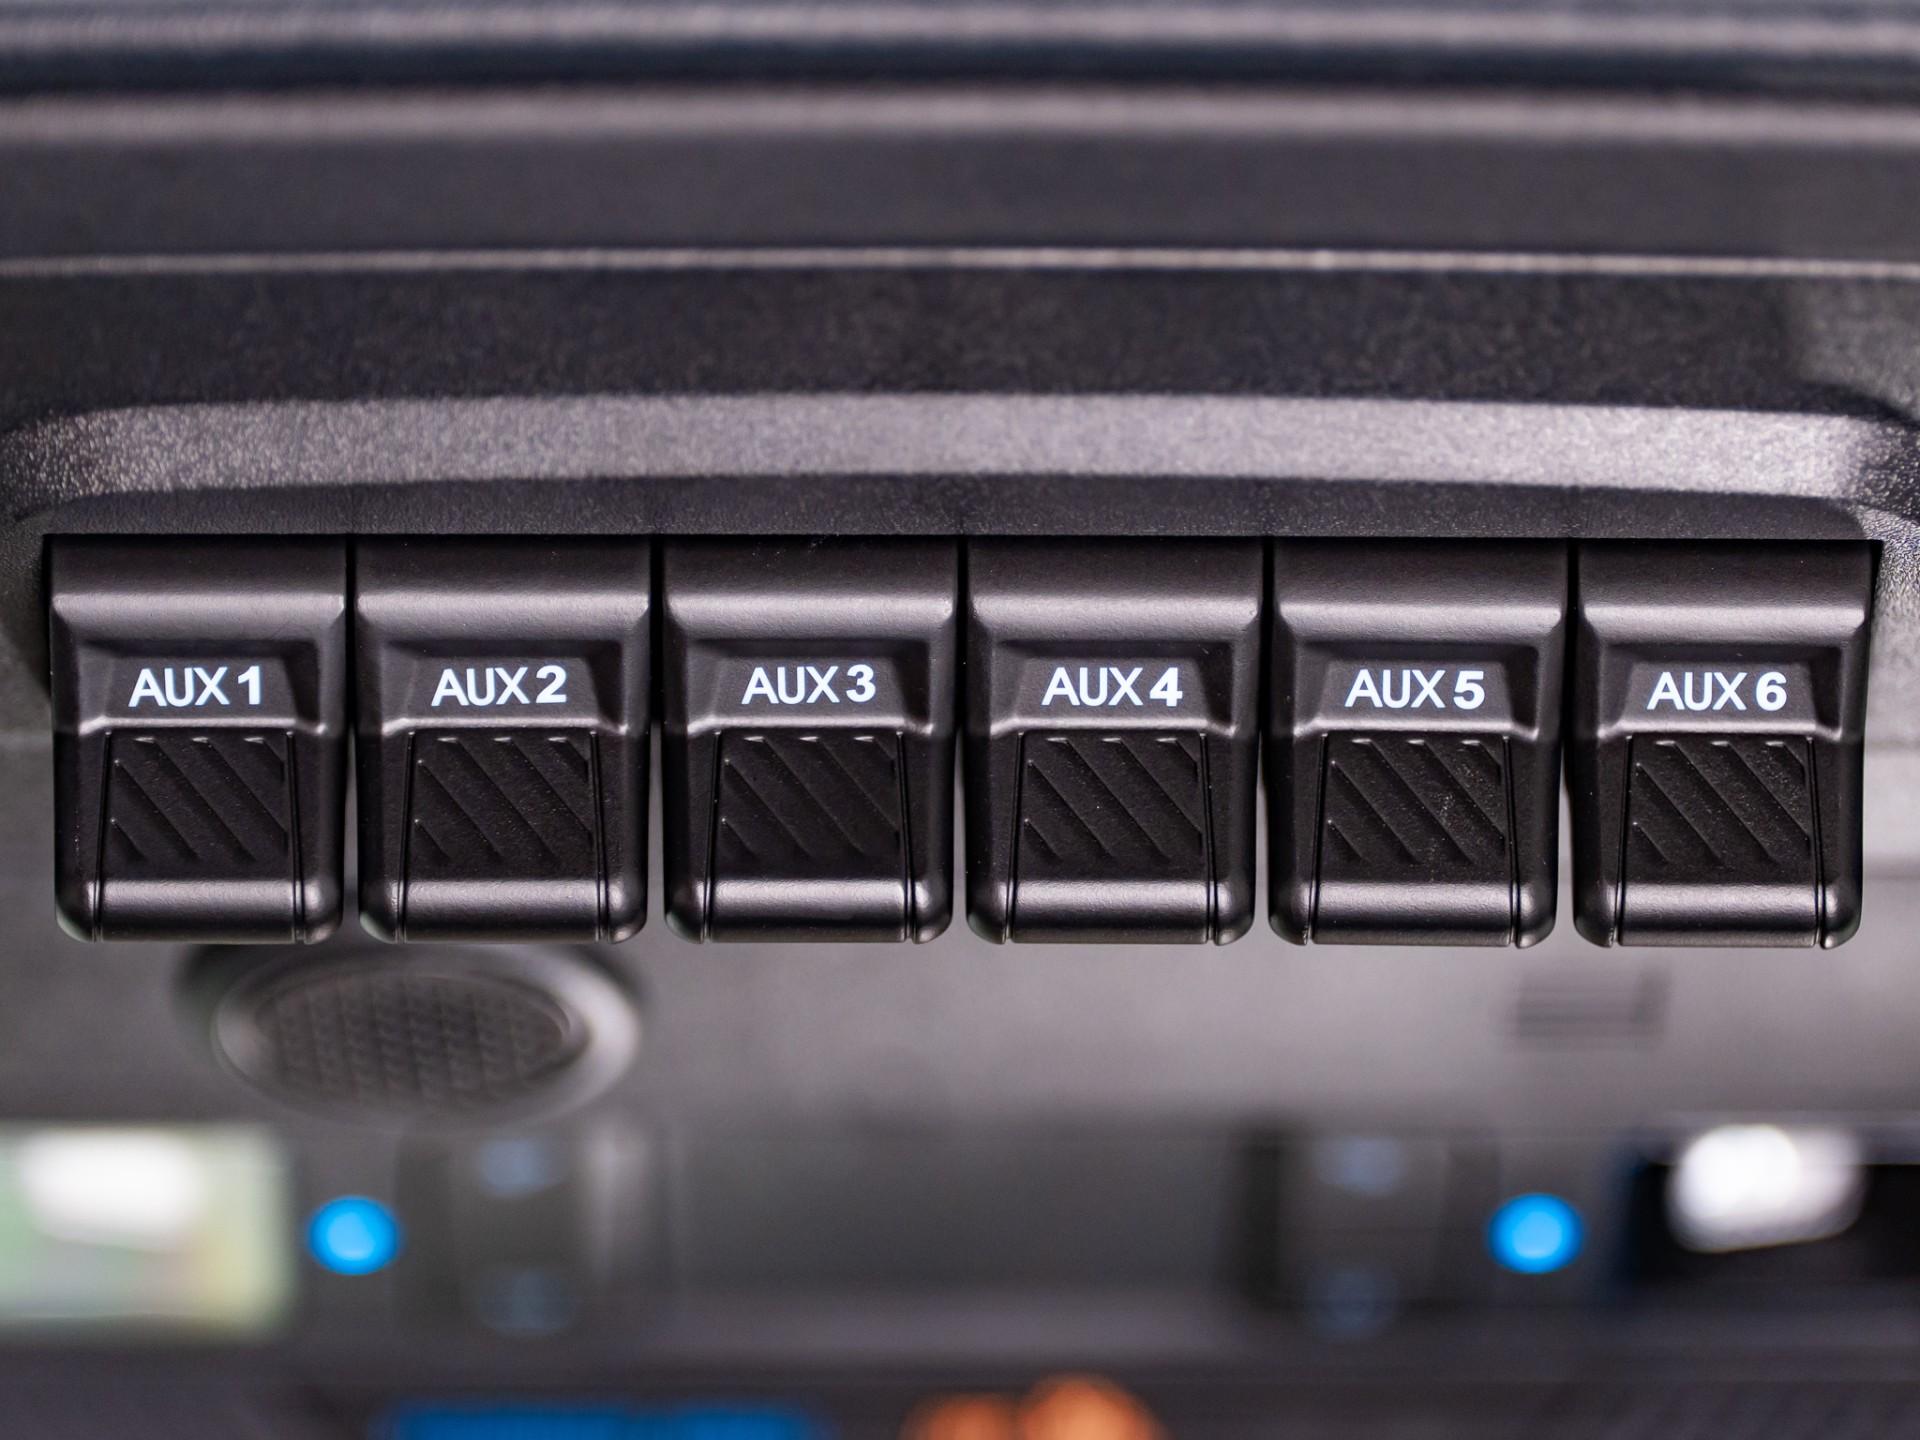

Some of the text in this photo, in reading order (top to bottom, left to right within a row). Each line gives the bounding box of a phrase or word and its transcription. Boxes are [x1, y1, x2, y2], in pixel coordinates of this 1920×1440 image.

[128, 665, 262, 708] AUX 1
[430, 664, 568, 708] AUX 2
[741, 663, 878, 706] AUX 3
[1041, 665, 1184, 708] AUX 4
[1344, 668, 1486, 711] AUX 5
[1646, 671, 1788, 713] AUX 6
